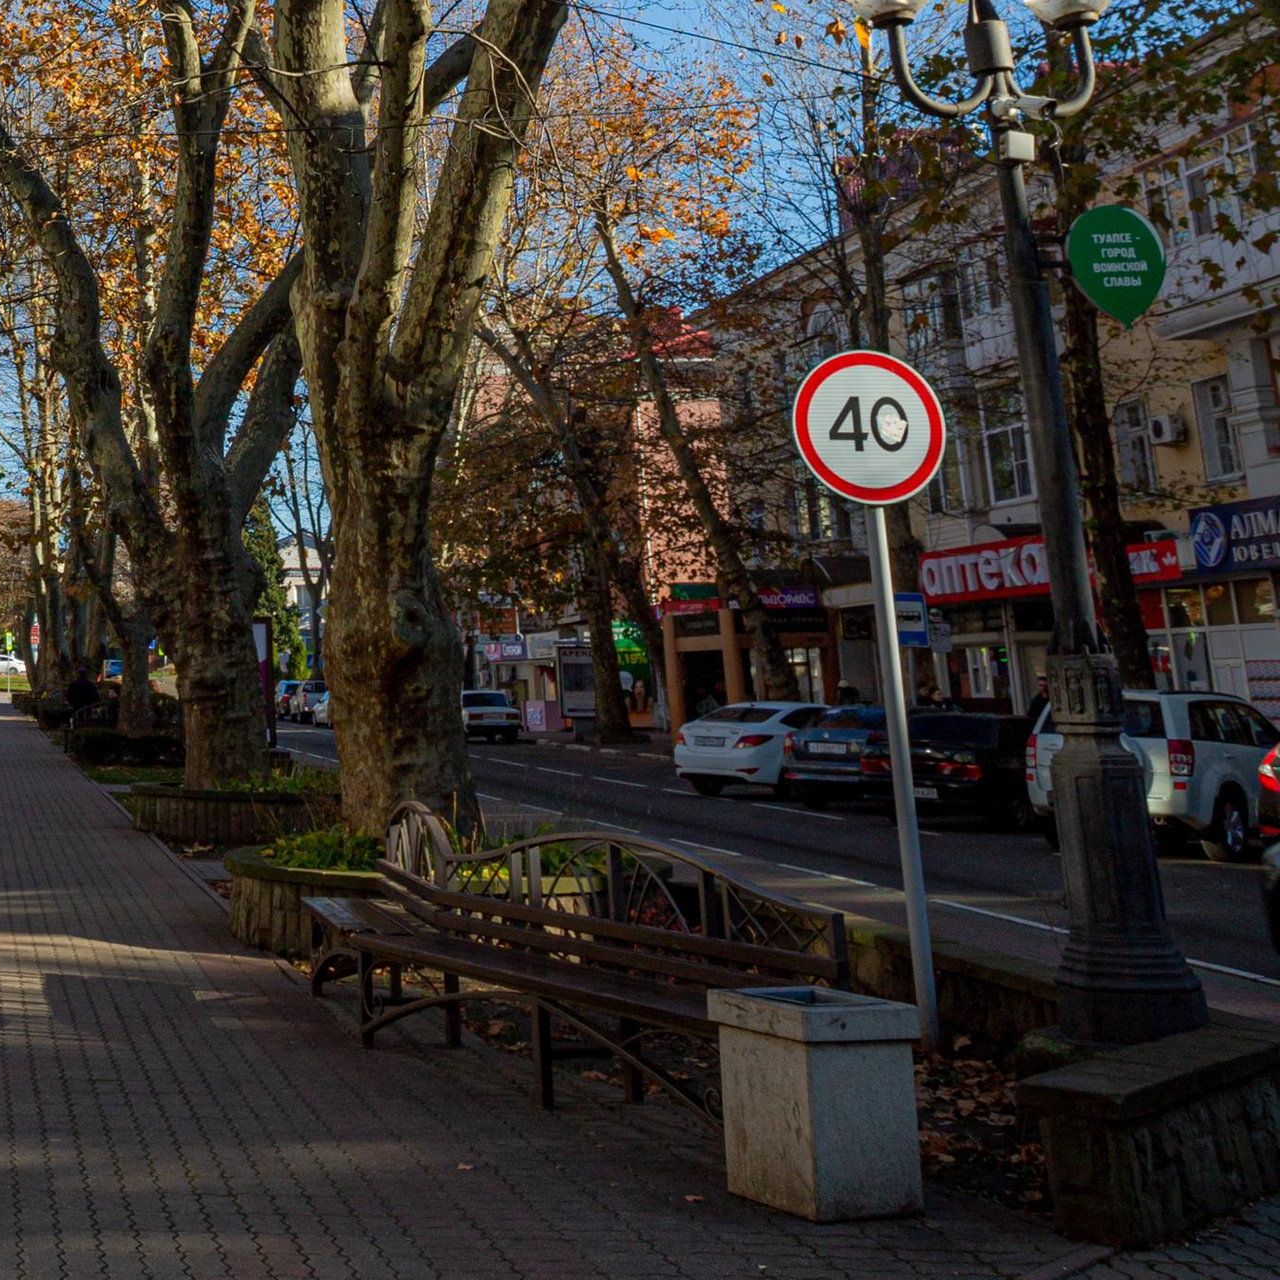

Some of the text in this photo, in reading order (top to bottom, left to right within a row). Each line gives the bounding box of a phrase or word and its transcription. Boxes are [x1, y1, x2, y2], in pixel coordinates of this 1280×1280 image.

[1091, 233, 1132, 244] ТУАПСЕ
[1101, 247, 1136, 259] ГОРОД
[1093, 260, 1148, 273] ВОИНСКОЙ
[1103, 276, 1142, 287] СЛАВЫ
[829, 396, 909, 453] 40
[1231, 509, 1280, 540] АЛМ
